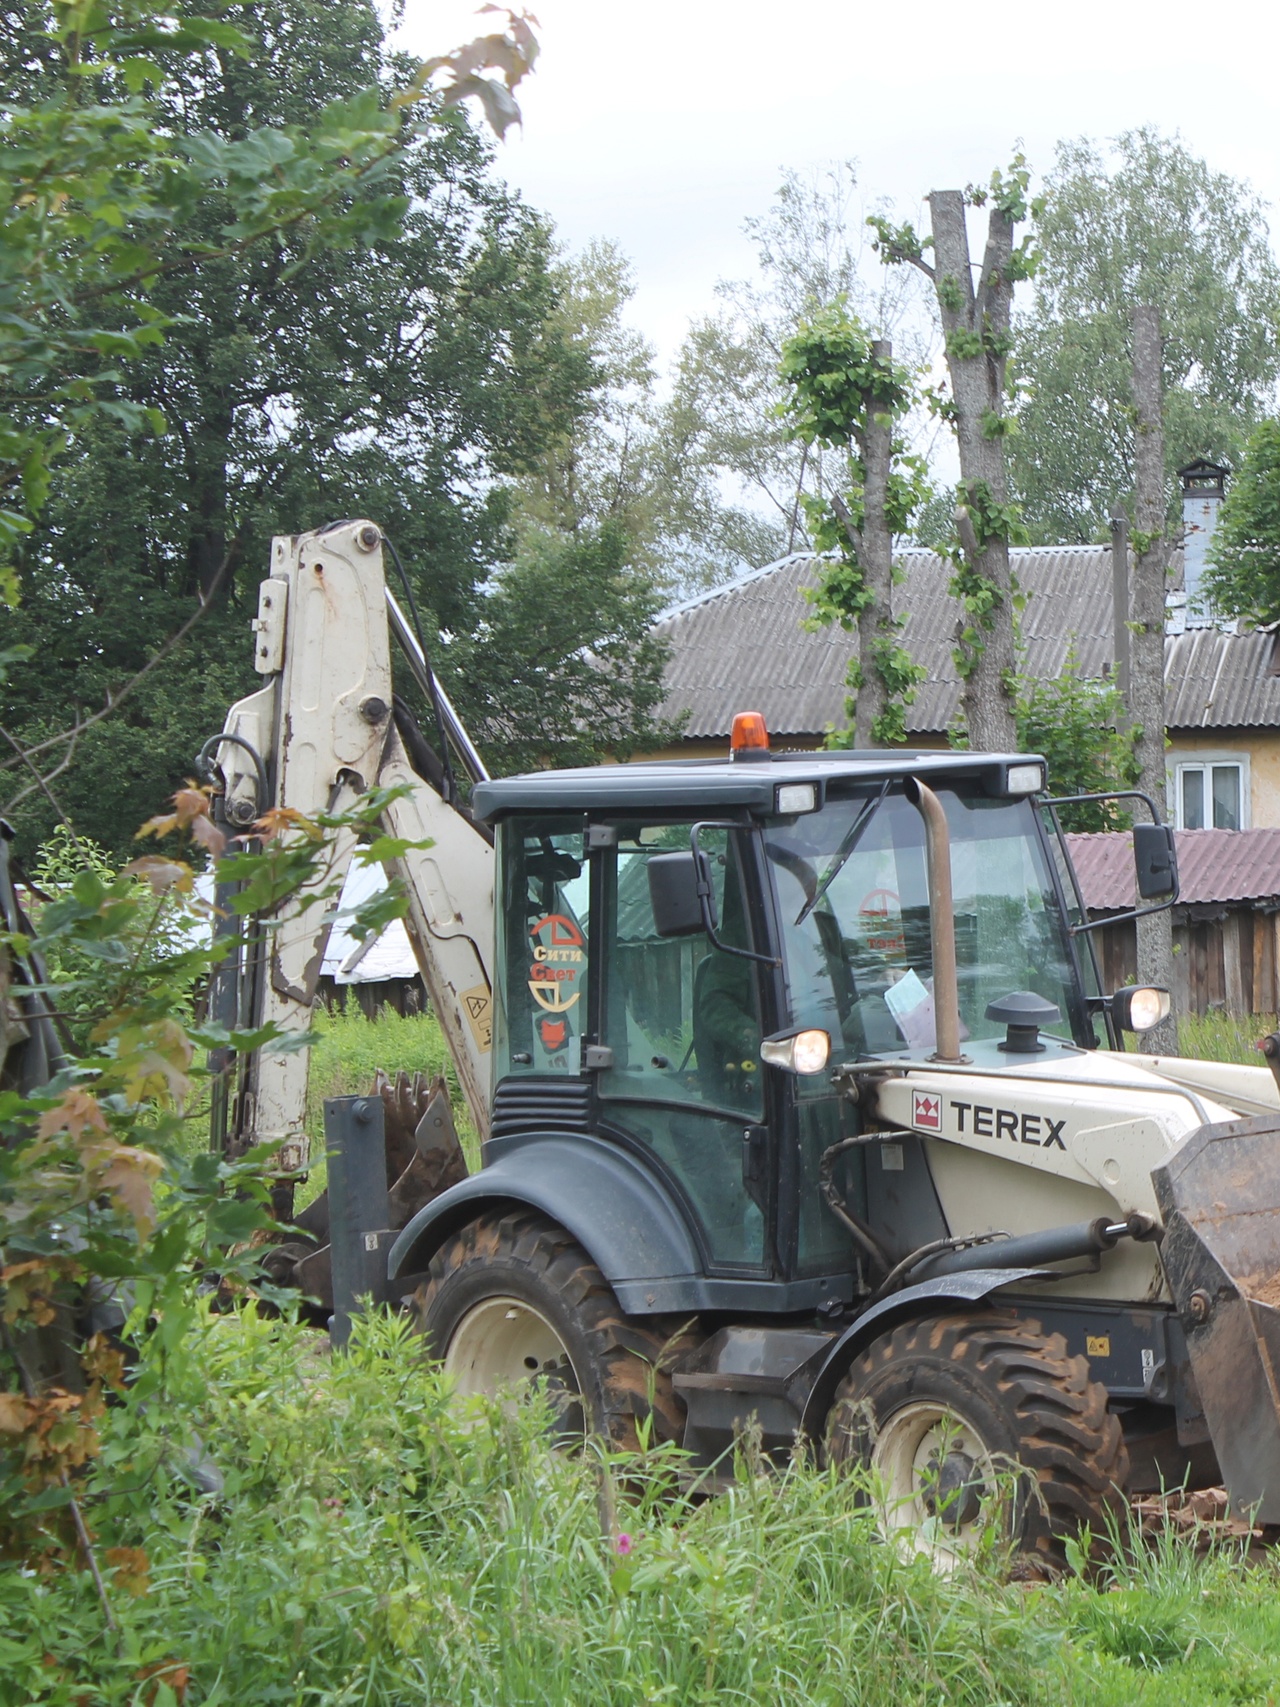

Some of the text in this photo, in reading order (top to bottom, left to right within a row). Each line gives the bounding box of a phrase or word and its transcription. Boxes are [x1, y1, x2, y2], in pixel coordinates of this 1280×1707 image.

[533, 945, 582, 962] Сити
[530, 962, 576, 981] Свет
[950, 1101, 1067, 1151] TEREX
